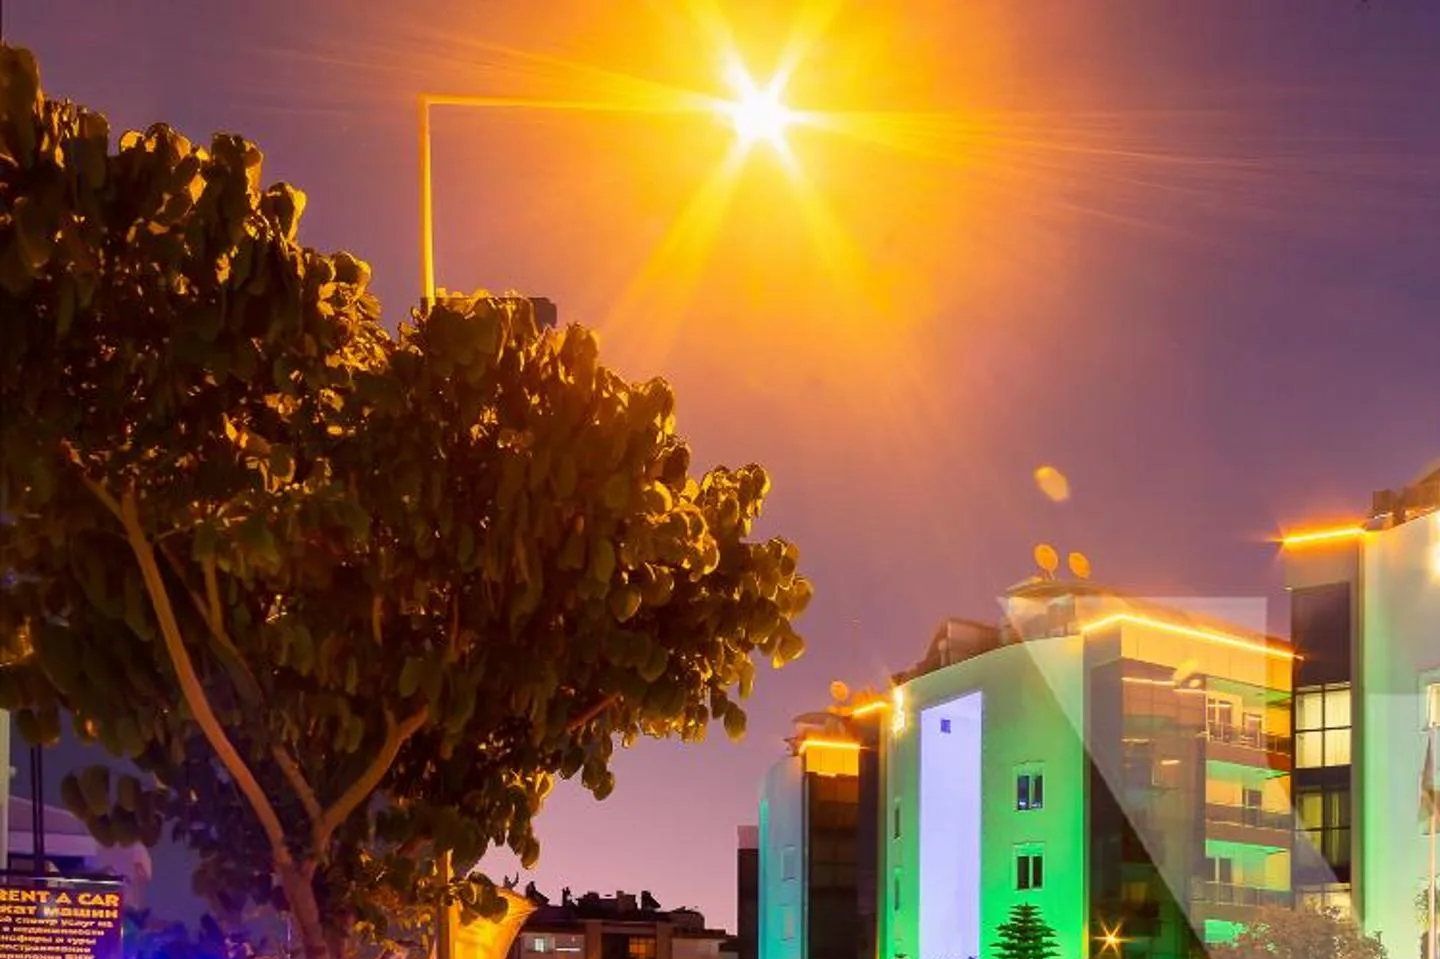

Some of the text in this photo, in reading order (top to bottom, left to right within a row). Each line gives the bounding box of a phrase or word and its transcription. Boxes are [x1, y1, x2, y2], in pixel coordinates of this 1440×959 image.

[0, 888, 120, 907] RENT A CAR
